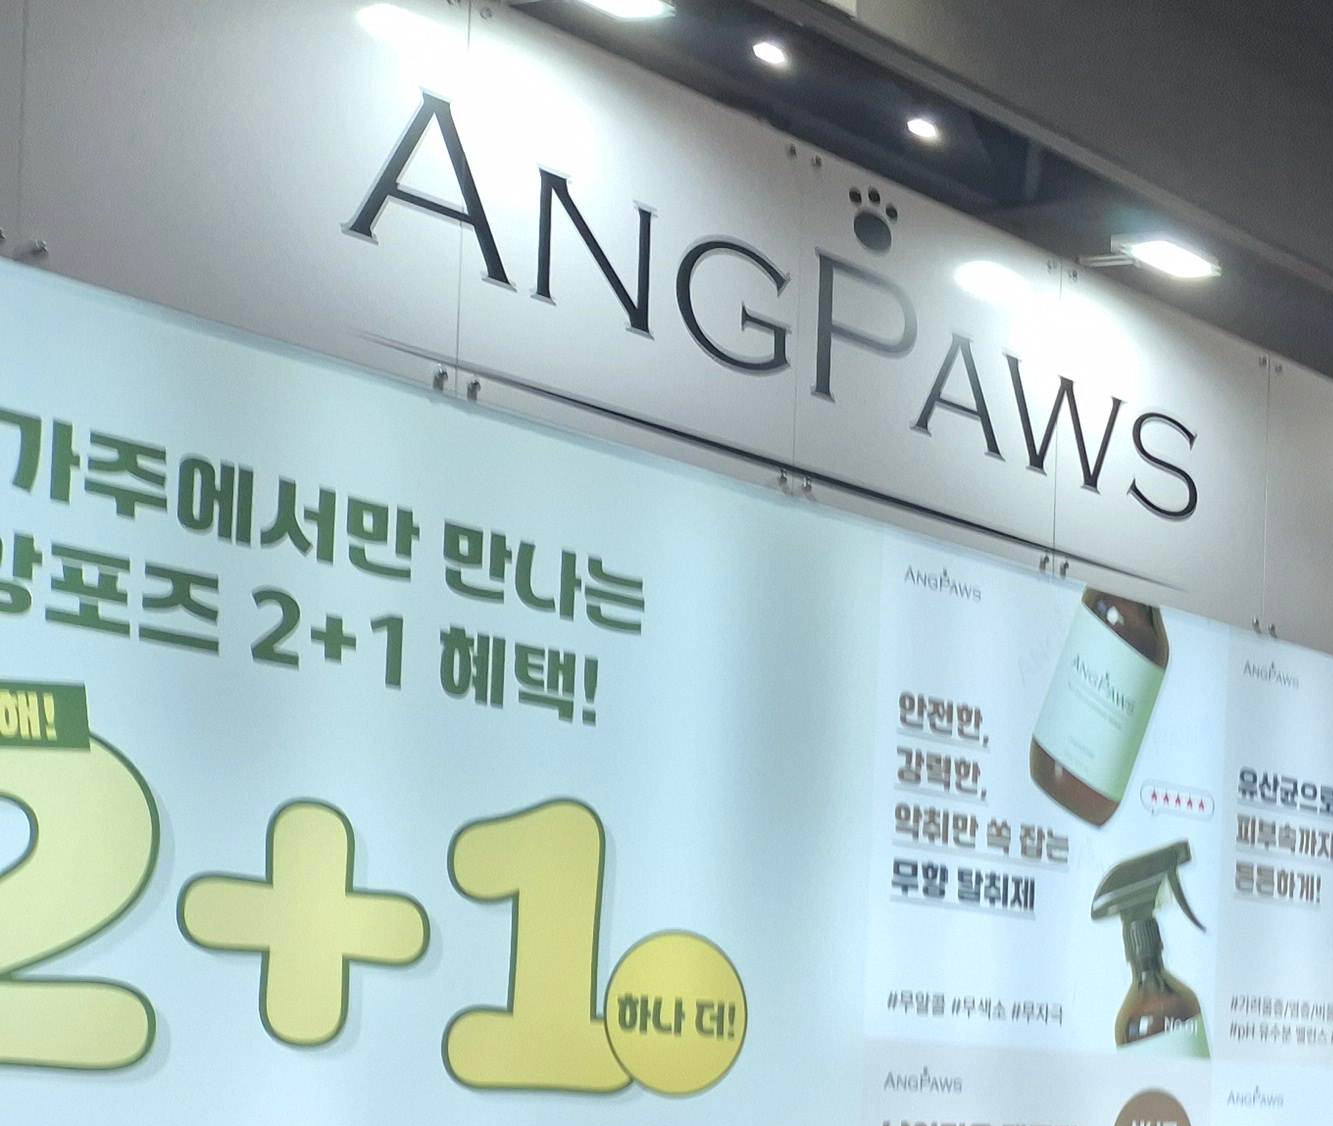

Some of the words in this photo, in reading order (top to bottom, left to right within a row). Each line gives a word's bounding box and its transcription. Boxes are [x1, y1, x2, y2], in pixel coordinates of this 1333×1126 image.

[340, 86, 1200, 522] ANGPAWS
[443, 517, 646, 636] 만나는
[903, 563, 982, 603] ANGPAWS
[250, 584, 404, 692] 2+1
[439, 621, 599, 728] 혜택!
[1242, 657, 1300, 691] ANGPAWS
[898, 688, 990, 749] 안전한,
[896, 745, 987, 802] 강력한,
[894, 801, 979, 850] 악취만
[986, 816, 1012, 856] 쏙
[1019, 822, 1070, 864] 잡는
[891, 856, 949, 900] 무향
[956, 865, 1036, 913] 탈취제
[617, 992, 686, 1038] 하나
[695, 997, 736, 1041] 더!
[883, 1070, 964, 1095] ANGPAWS
